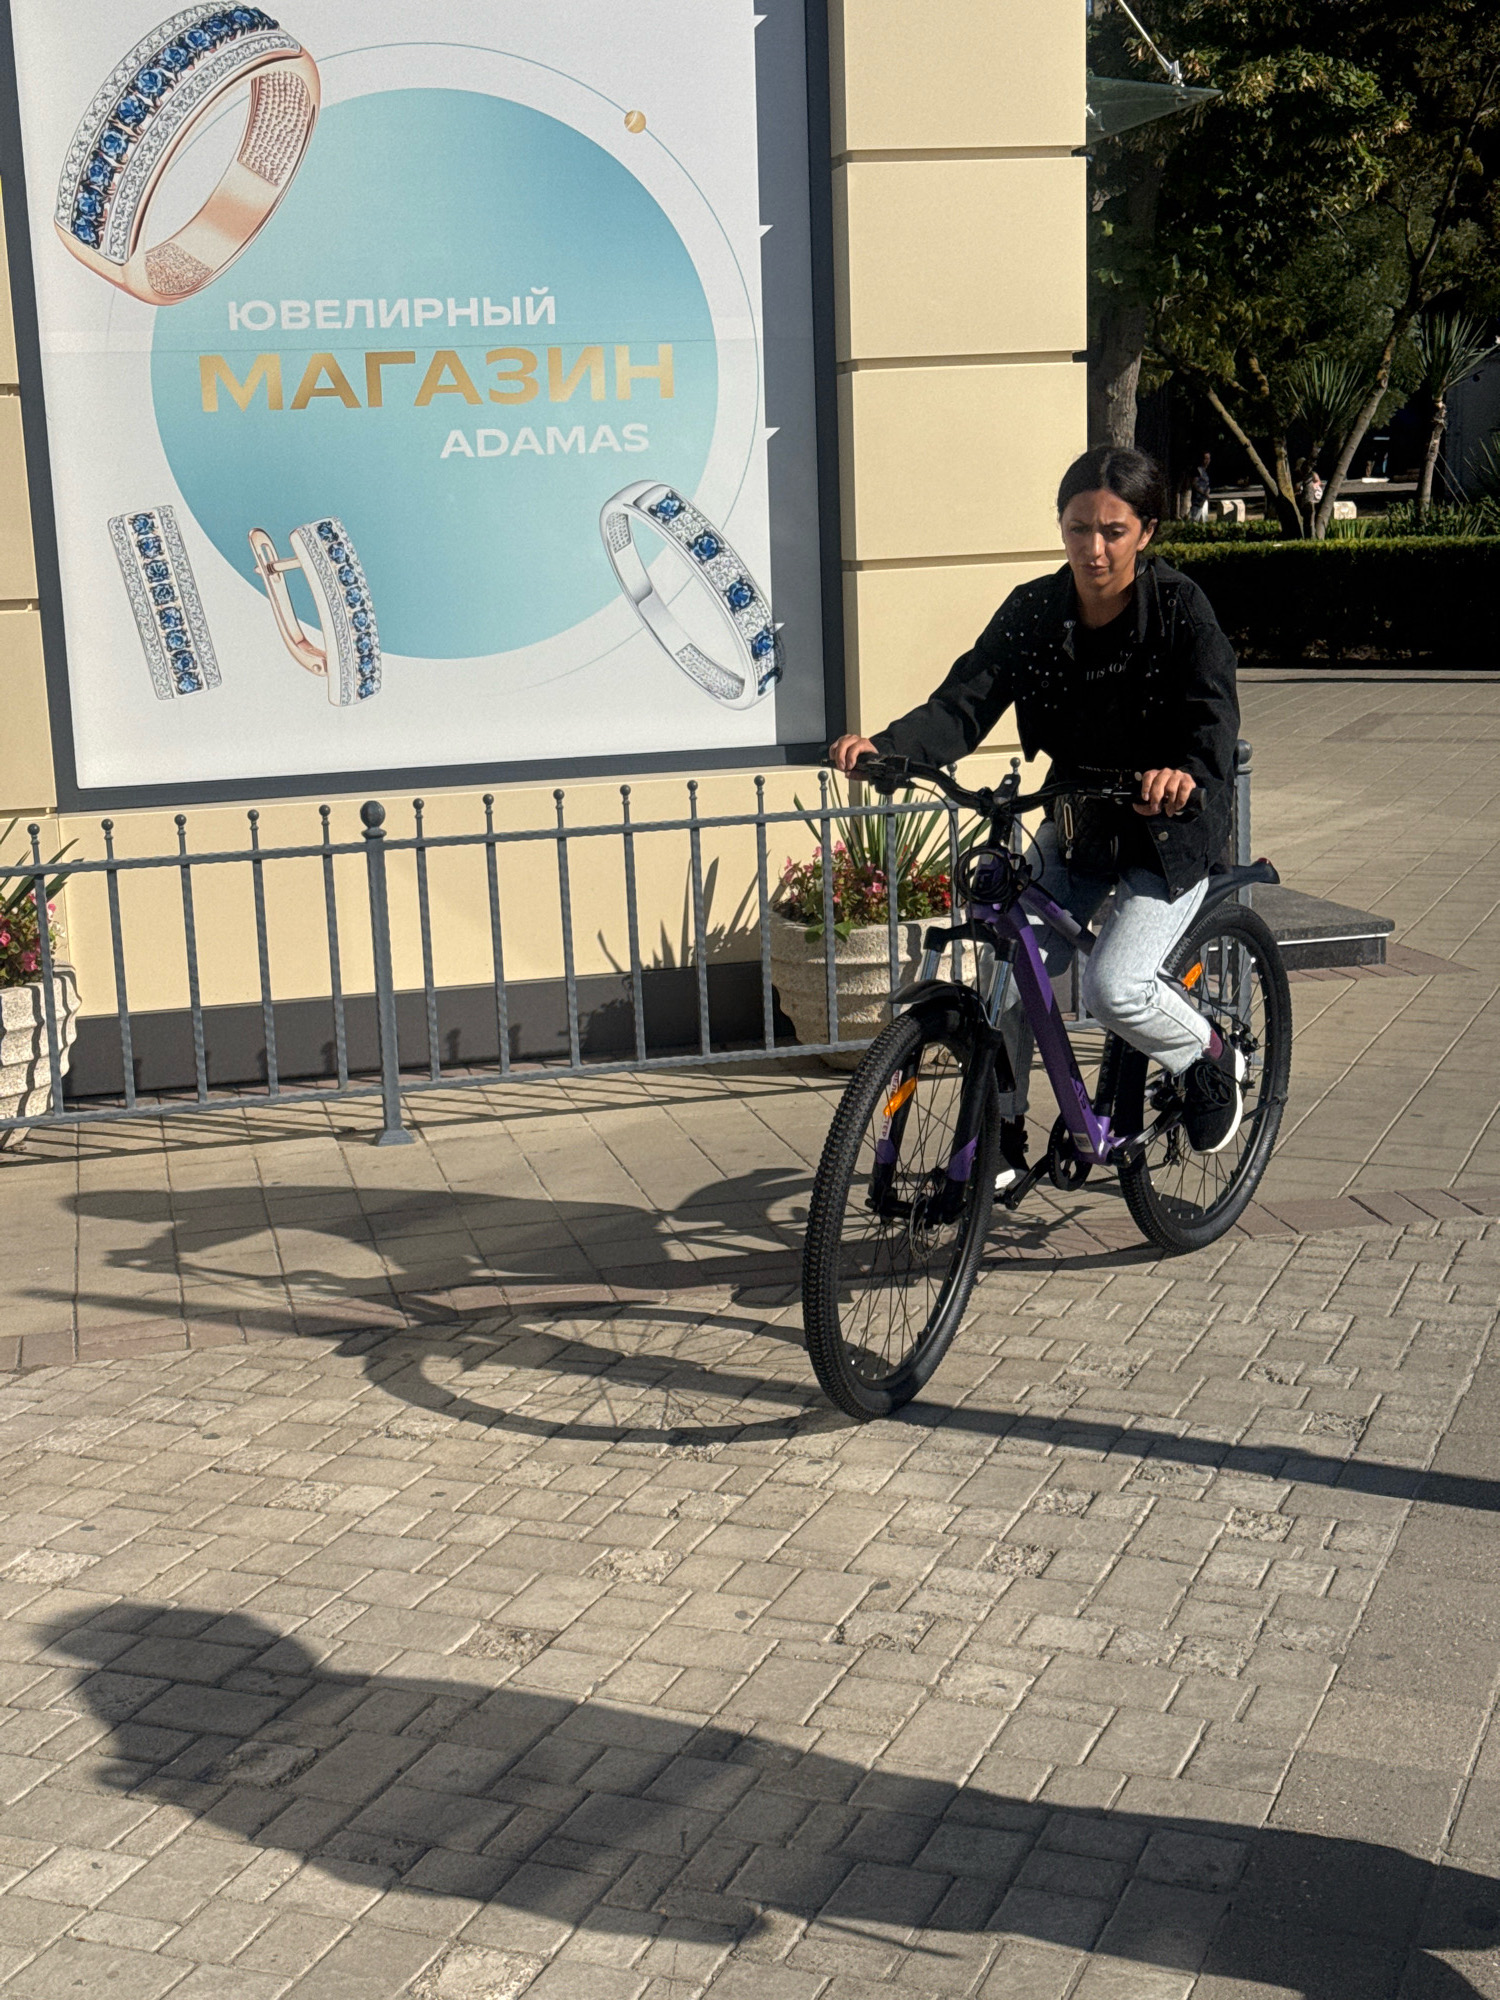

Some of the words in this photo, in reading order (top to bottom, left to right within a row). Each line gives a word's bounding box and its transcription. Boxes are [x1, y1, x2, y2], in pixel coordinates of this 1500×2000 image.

[228, 286, 556, 332] ЮВЕЛИРНЫЙ
[199, 343, 674, 412] МАГАЗИН
[440, 423, 650, 459] ADAMAS
